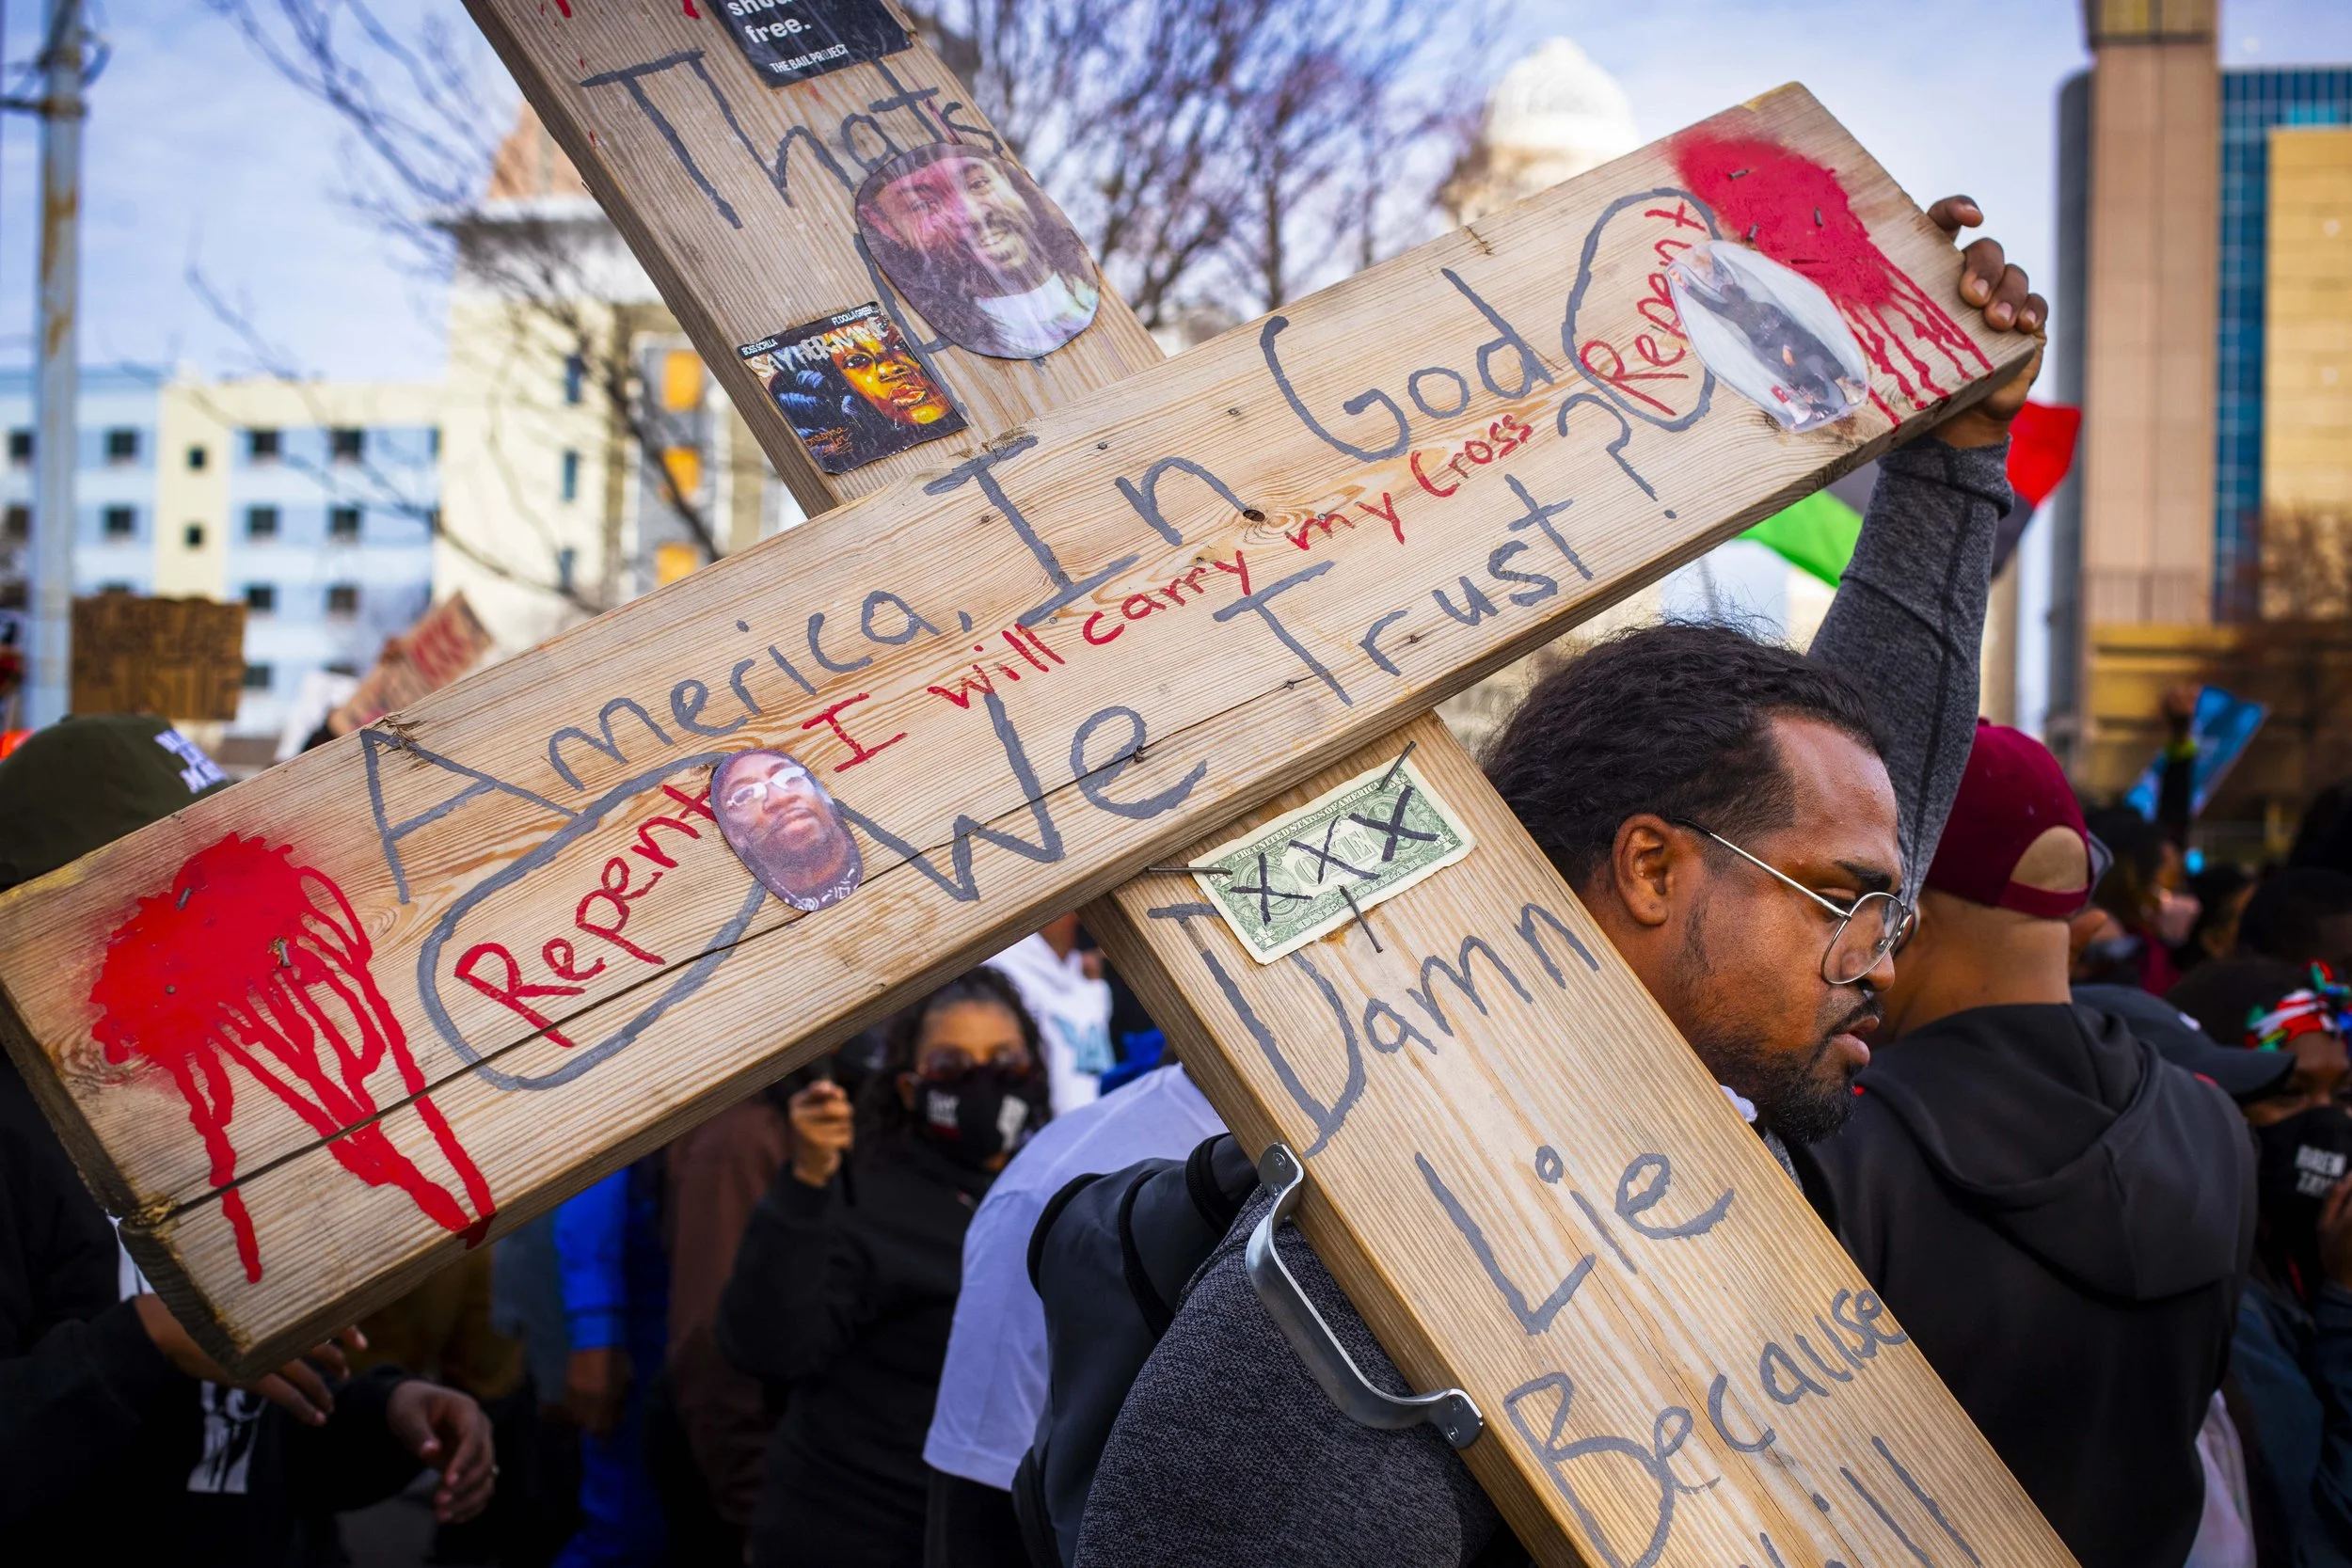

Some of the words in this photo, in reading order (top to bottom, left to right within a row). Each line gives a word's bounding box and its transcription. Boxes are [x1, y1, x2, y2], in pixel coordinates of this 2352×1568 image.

[744, 18, 812, 43] free.
[769, 58, 792, 73] THE
[788, 55, 814, 70] BAIL
[923, 436, 1252, 626] In
[1259, 267, 1555, 463] God
[802, 692, 909, 772] I
[928, 625, 1065, 709] will
[1083, 550, 1251, 645] carry
[1286, 493, 1405, 551] my
[1410, 415, 1534, 498] Cross
[834, 692, 1208, 901] We
[1291, 811, 1327, 832] STATES
[1337, 781, 1380, 808] AMERICA
[453, 784, 717, 1048] Repent
[1414, 1145, 1735, 1336] Lie
[1504, 1287, 1909, 1568] Because
